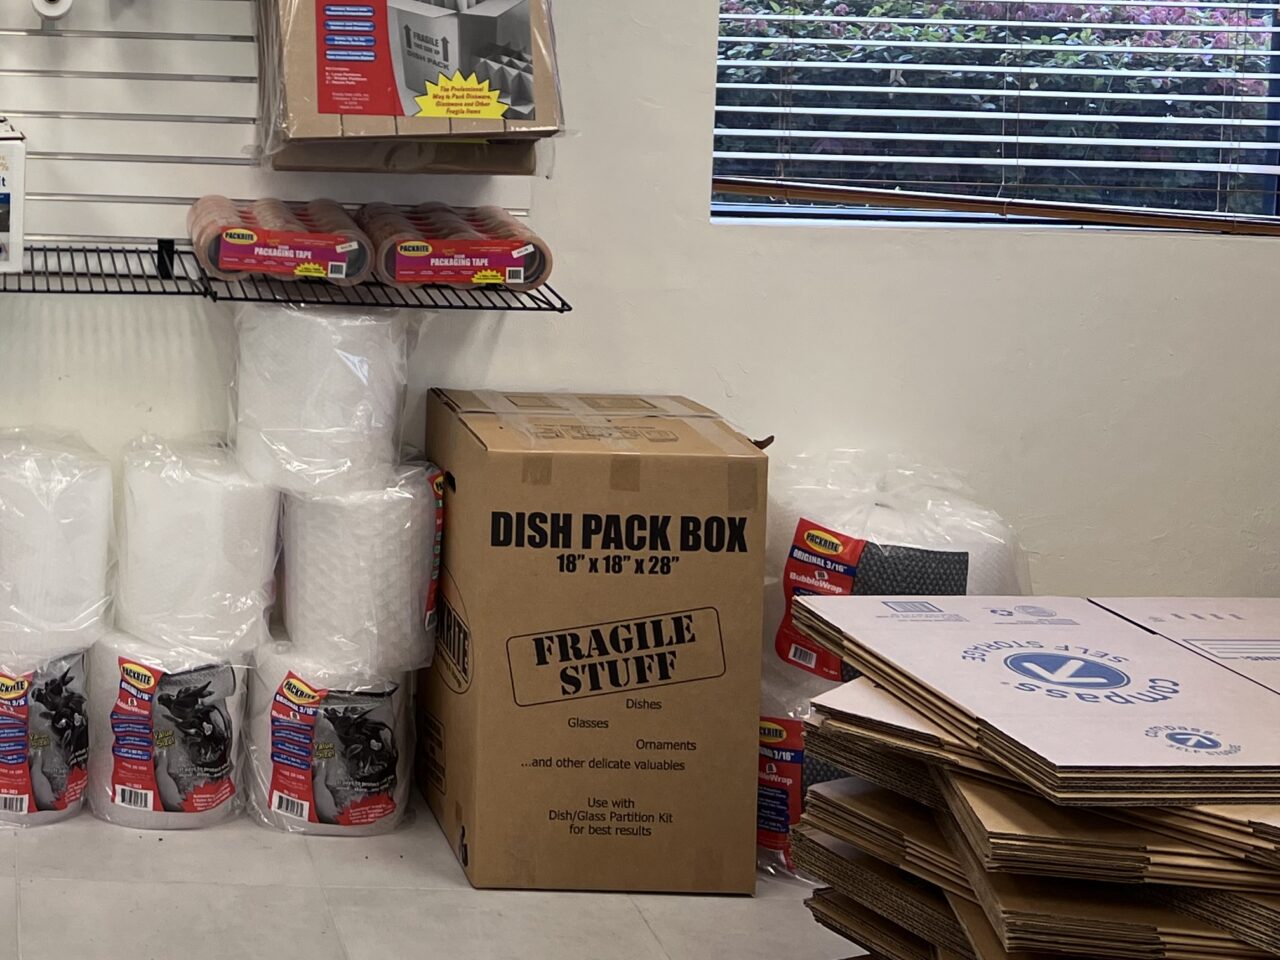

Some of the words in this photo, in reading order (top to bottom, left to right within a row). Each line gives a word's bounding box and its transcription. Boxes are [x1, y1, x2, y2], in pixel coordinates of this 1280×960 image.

[225, 232, 254, 241] PACKRITE
[254, 247, 294, 258] PACKAGING
[296, 250, 312, 259] TAPE
[400, 244, 429, 252] PACKRITE
[430, 258, 471, 266] PACKAGING
[472, 258, 489, 266] TAPE
[490, 511, 573, 549] DISH
[582, 513, 671, 552] PACK
[680, 516, 748, 553] BOX
[806, 532, 842, 554] PACKRITE
[557, 554, 585, 573] 18"
[588, 559, 600, 573] x
[603, 555, 631, 574] 18"
[634, 560, 645, 574] x
[648, 556, 679, 575] 28"
[793, 548, 825, 567] ORIGINAL
[789, 572, 843, 595] BubbleWrap
[532, 614, 696, 667] FRAGILE
[961, 640, 1044, 662] STORAGE
[1055, 644, 1129, 663] SELF
[122, 665, 152, 686] PACKRITE
[559, 650, 677, 696] STUFF
[1014, 677, 1180, 705] compass
[626, 698, 662, 710] Dishes
[568, 717, 609, 729] Glasses
[636, 739, 697, 751] Ornaments
[521, 757, 553, 768] ...and
[556, 757, 585, 769] other
[588, 758, 631, 769] delicate
[634, 759, 686, 771] valuables
[587, 797, 608, 808] Use
[611, 797, 635, 809] with
[548, 810, 607, 823] Dish/Glass
[610, 811, 656, 823] Partition
[658, 812, 673, 823] Kit
[569, 824, 585, 835] for
[588, 824, 611, 836] best
[615, 825, 652, 837] results
